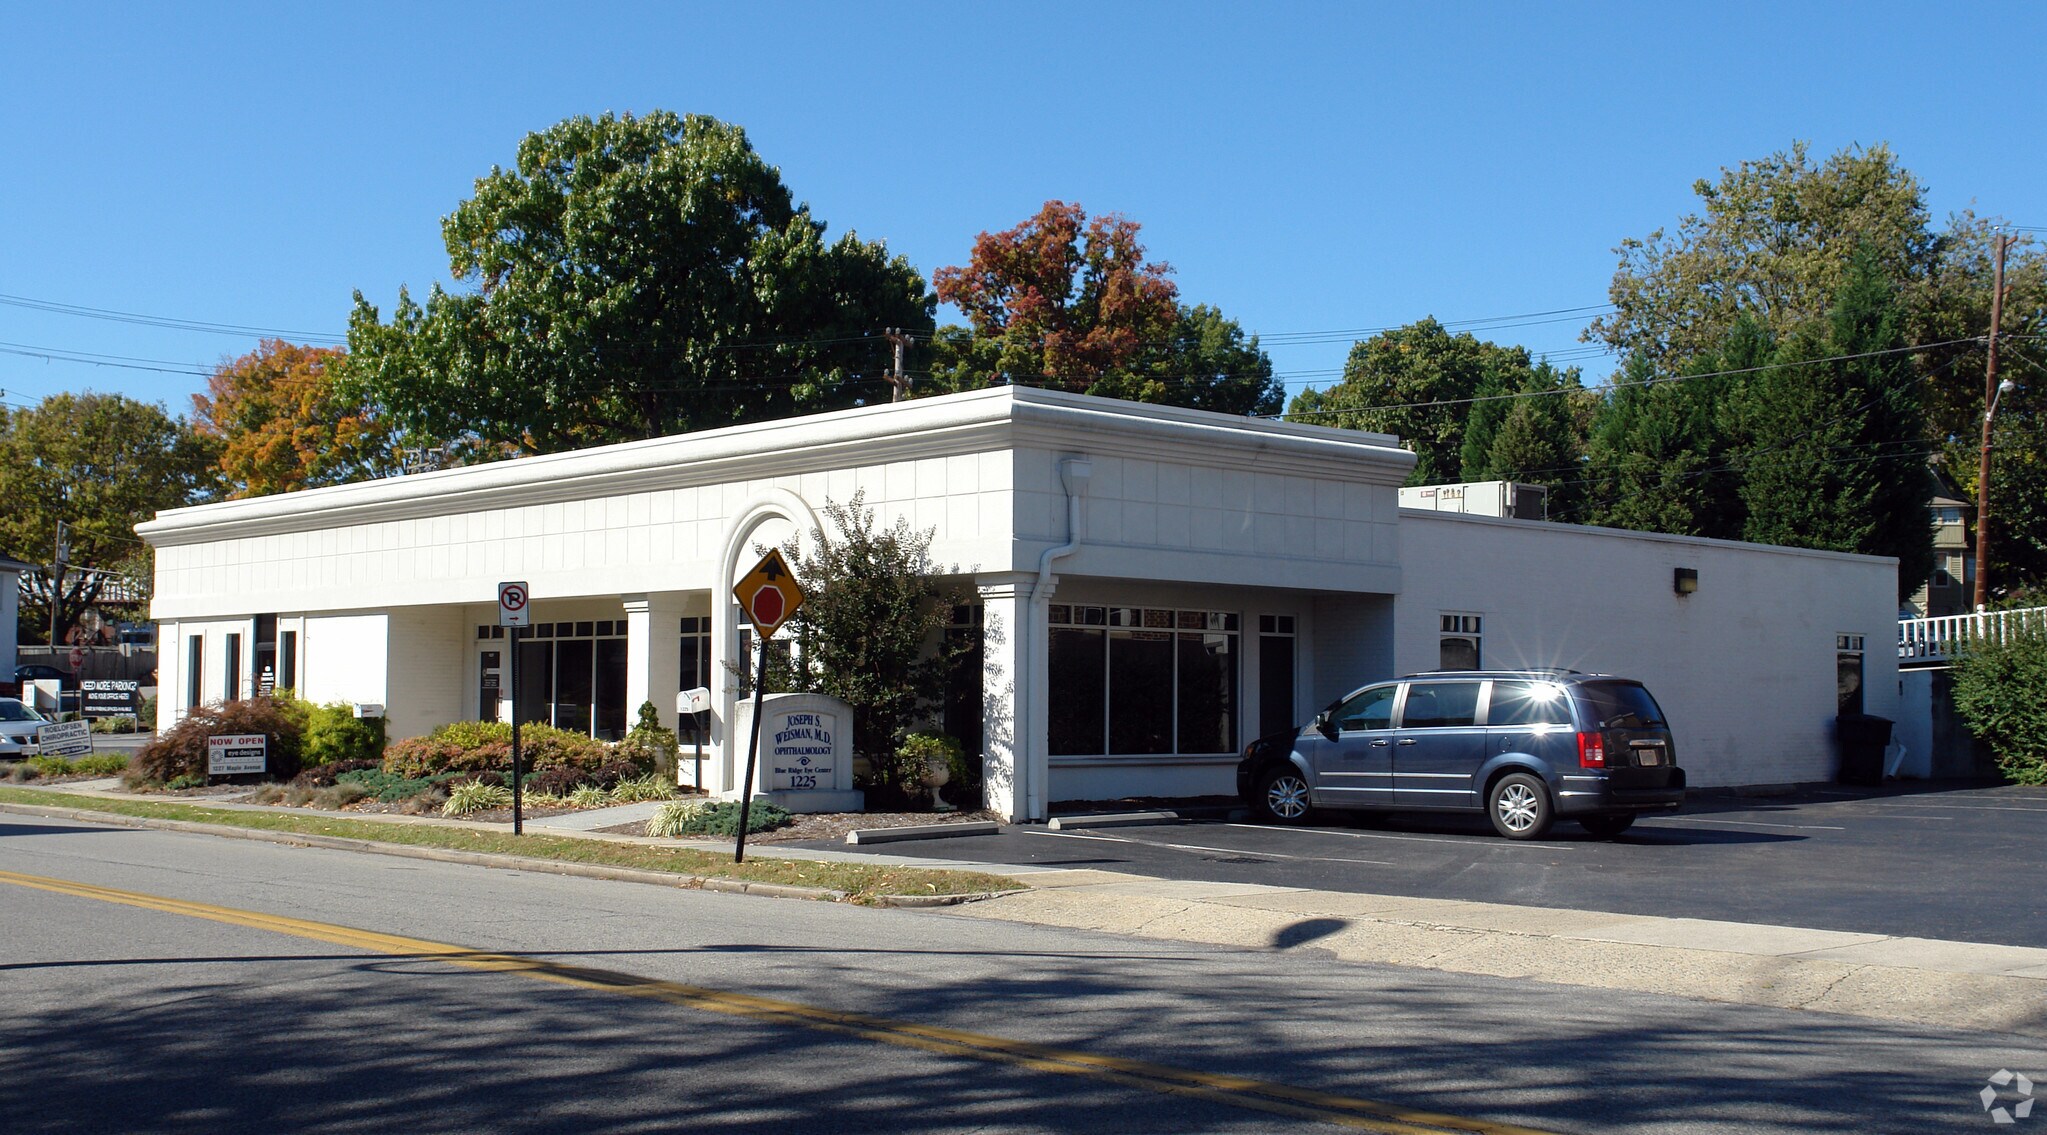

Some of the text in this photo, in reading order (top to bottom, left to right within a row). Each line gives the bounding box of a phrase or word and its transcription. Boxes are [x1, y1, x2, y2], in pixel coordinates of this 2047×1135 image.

[81, 681, 137, 691] NEED MORE PARKING?
[44, 722, 82, 734] ROELOFSEN
[785, 714, 822, 730] JOSEPH S.
[41, 729, 87, 742] CHIROPRACTIC
[238, 737, 264, 745] OPEN
[775, 728, 832, 745] WEISMAN, M.D.
[239, 749, 261, 757] designs
[774, 746, 832, 755] OPHTHALMOLOGY
[790, 775, 816, 789] 1225
